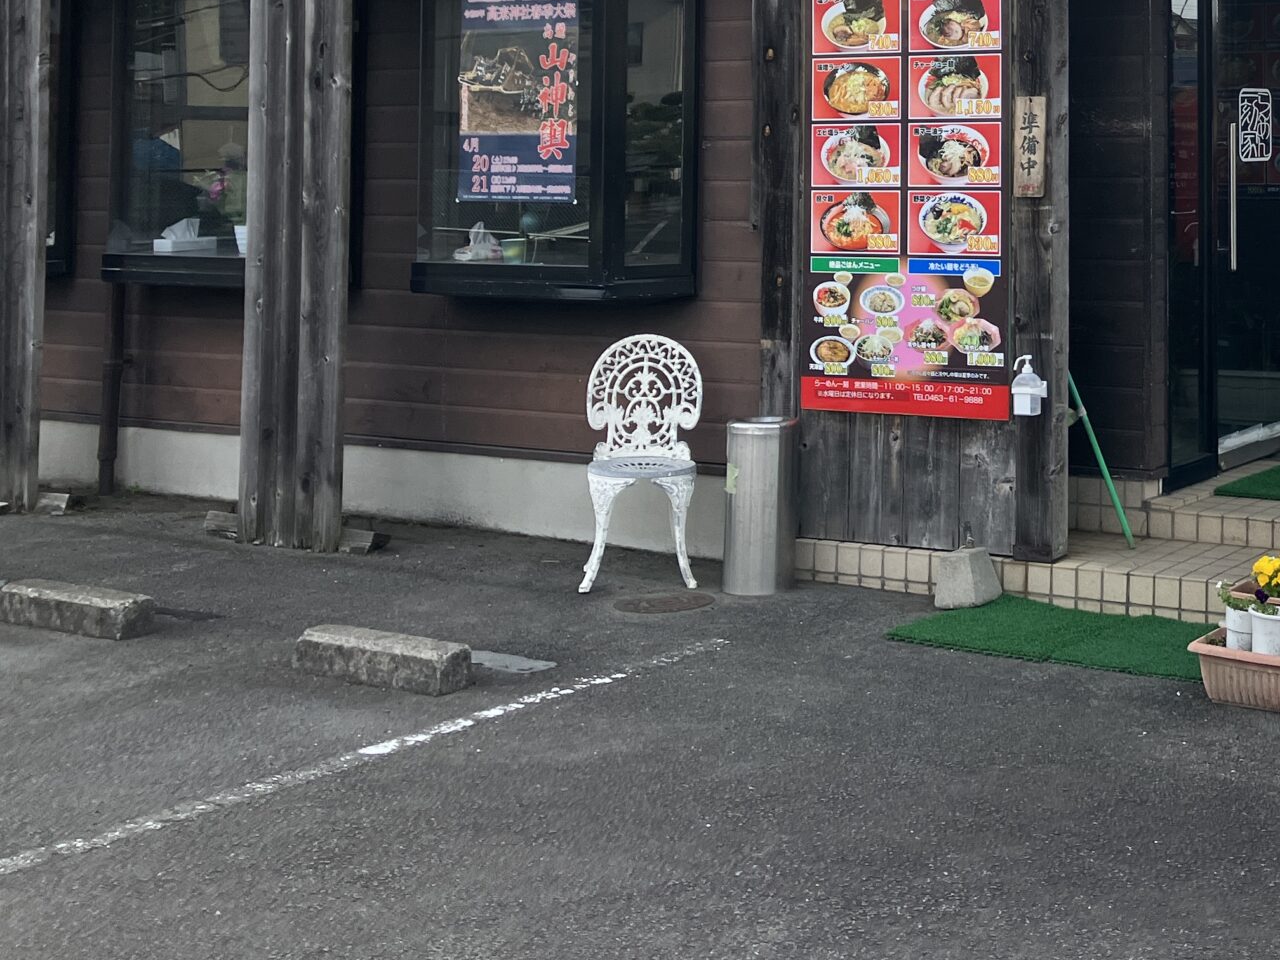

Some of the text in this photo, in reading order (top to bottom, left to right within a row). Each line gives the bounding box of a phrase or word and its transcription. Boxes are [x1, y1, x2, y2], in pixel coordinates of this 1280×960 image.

[462, 137, 480, 153] 4月
[1019, 112, 1040, 177] 準備中
[472, 154, 490, 172] 20
[471, 175, 489, 193] 21
